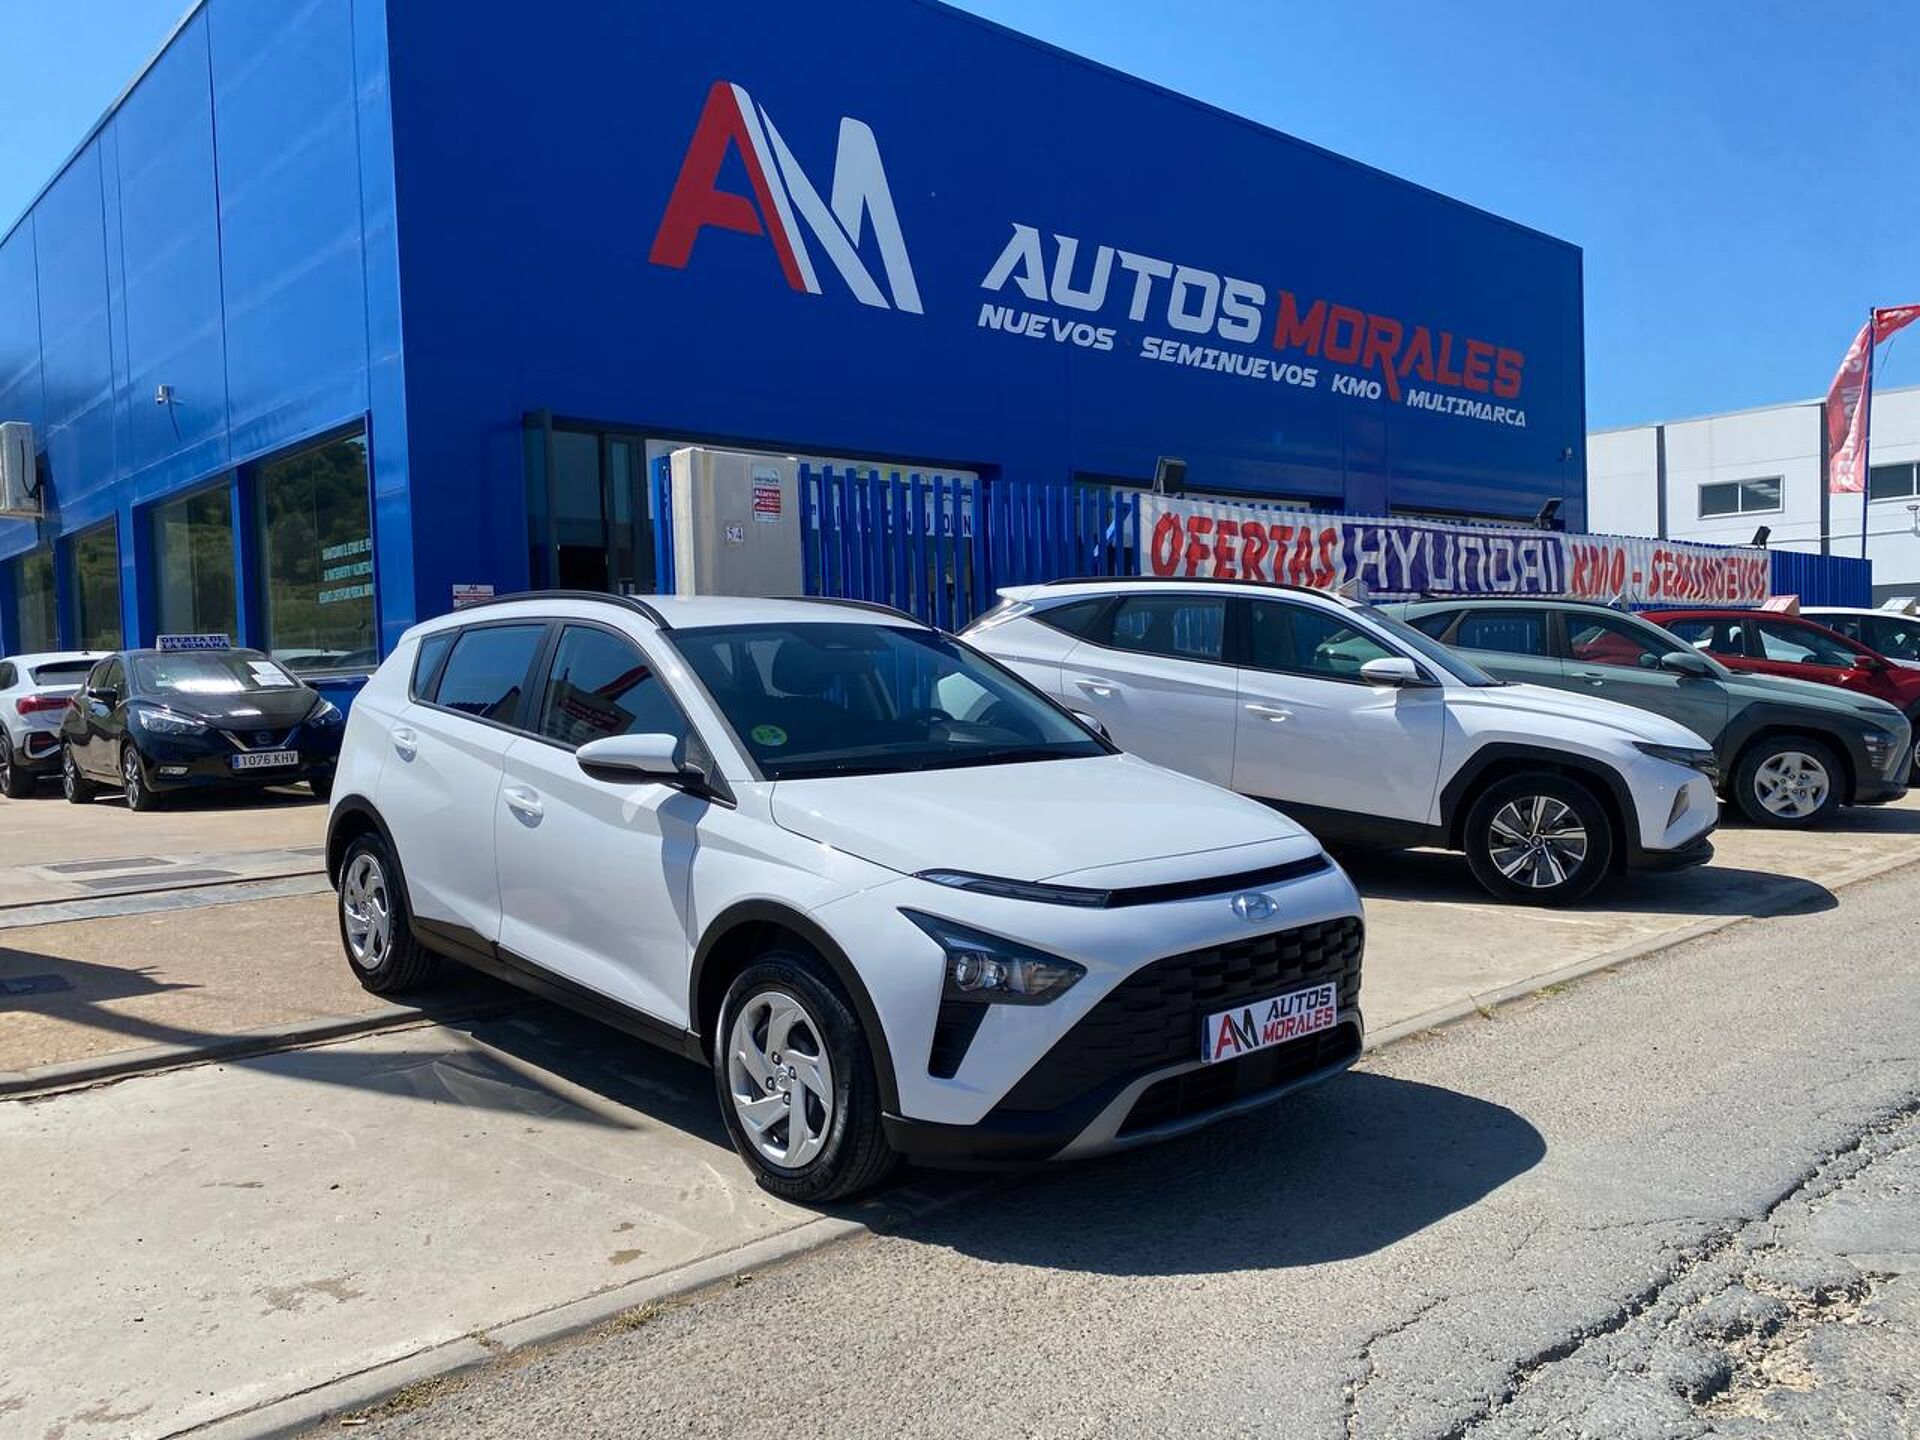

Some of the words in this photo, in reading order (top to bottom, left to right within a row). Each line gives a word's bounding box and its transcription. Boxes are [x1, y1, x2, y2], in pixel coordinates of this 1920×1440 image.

[648, 79, 924, 314] AM
[981, 222, 1266, 343] AUTOS
[1273, 289, 1524, 402] MORALES
[978, 303, 1116, 350] NUEVOS
[1140, 336, 1318, 388] SEMINUEVOS
[1406, 389, 1526, 427] MULTIMARCA
[1152, 512, 1338, 588] OFERTAS
[1354, 527, 1558, 592] HYUNDAI
[241, 754, 271, 766] 1076
[273, 752, 296, 764] KHV
[1214, 1008, 1260, 1060] AM
[1262, 1006, 1334, 1044] MORALES
[1266, 986, 1332, 1021] AUTOS
